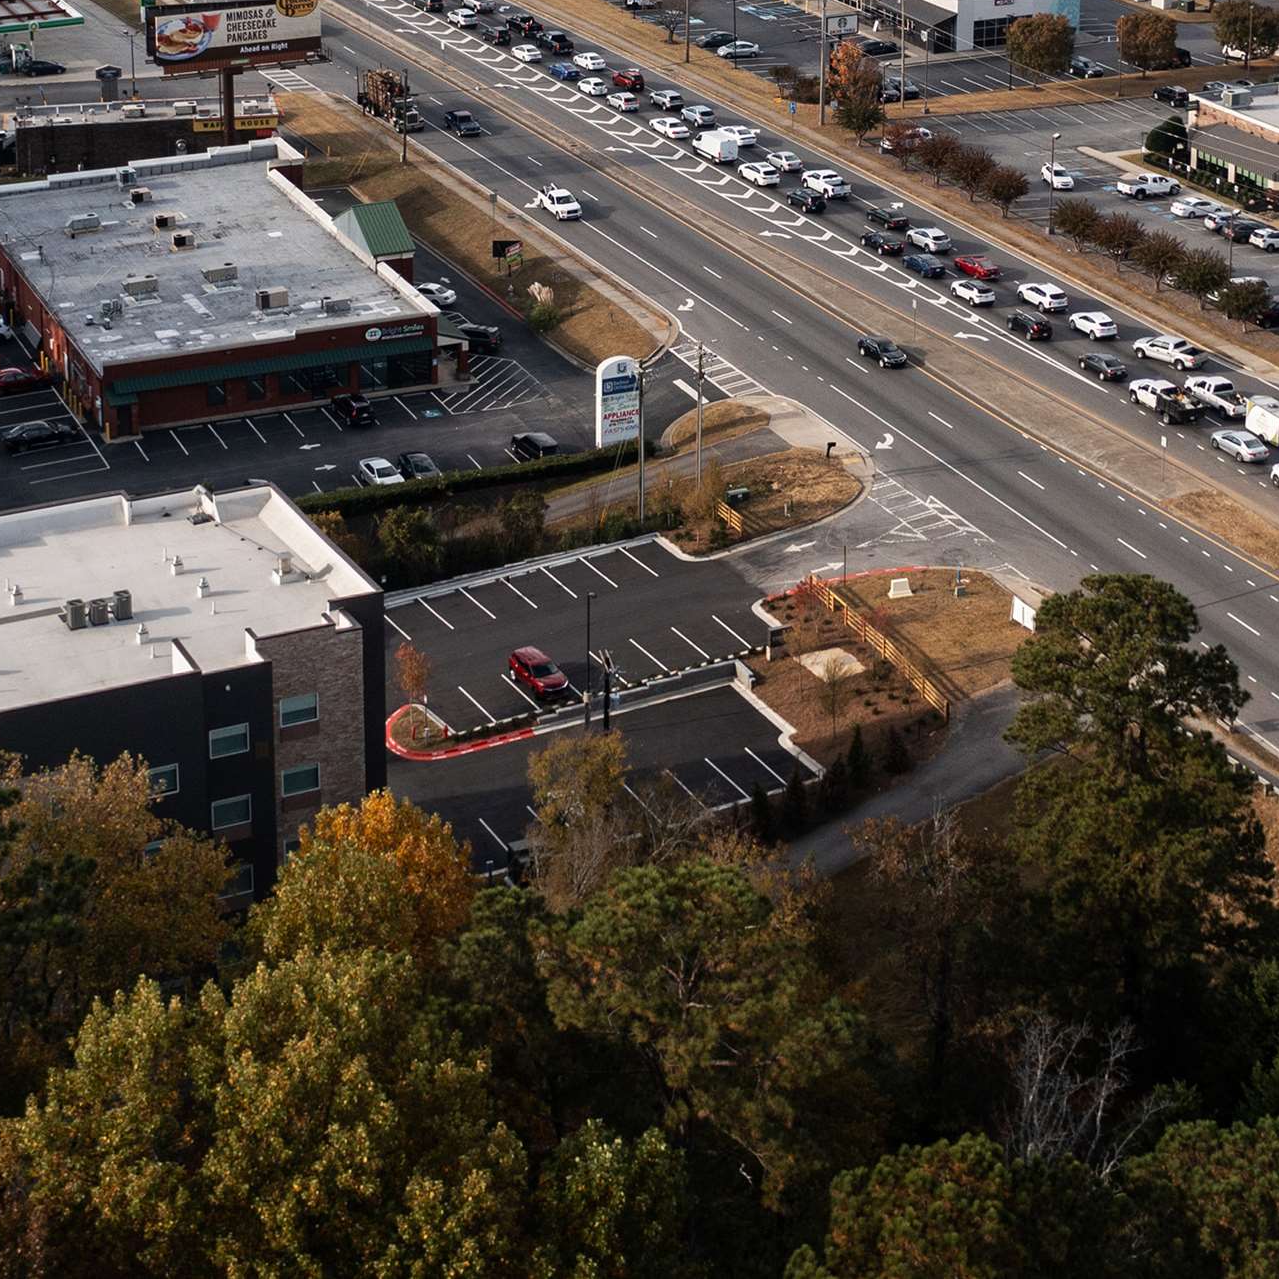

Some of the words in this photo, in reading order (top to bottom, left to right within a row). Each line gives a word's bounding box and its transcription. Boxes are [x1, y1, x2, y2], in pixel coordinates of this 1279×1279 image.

[226, 10, 263, 22] MIMOSAS
[226, 19, 277, 32] CHEESECAKE
[227, 31, 268, 43] PANCAKES
[240, 45, 260, 53] Ahead
[271, 42, 288, 50] Right
[403, 324, 424, 332] Smiles
